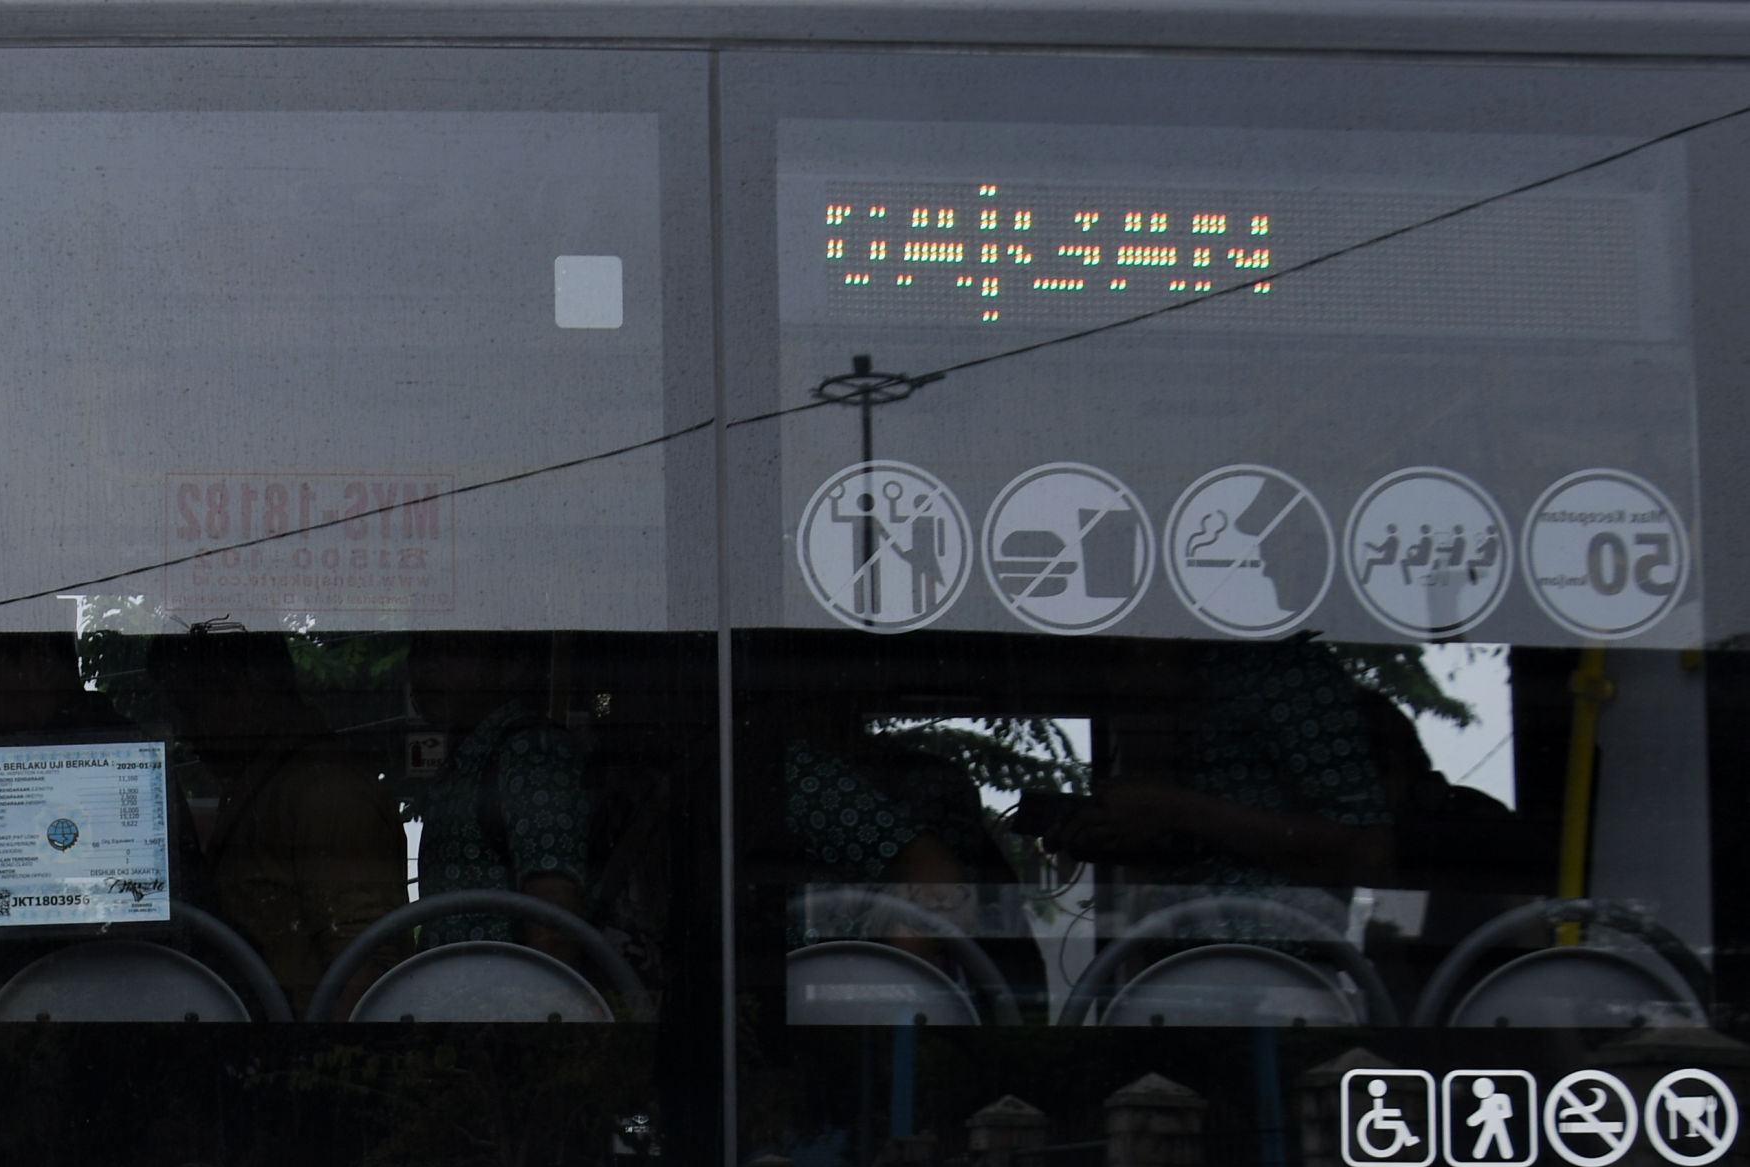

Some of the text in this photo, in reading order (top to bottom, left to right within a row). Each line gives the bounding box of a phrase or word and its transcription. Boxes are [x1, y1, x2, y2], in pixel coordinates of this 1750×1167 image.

[3, 761, 47, 771] BERLAKU
[49, 760, 64, 769] UJI
[65, 759, 109, 769] BERKALA
[11, 894, 91, 908] JKT1803956
